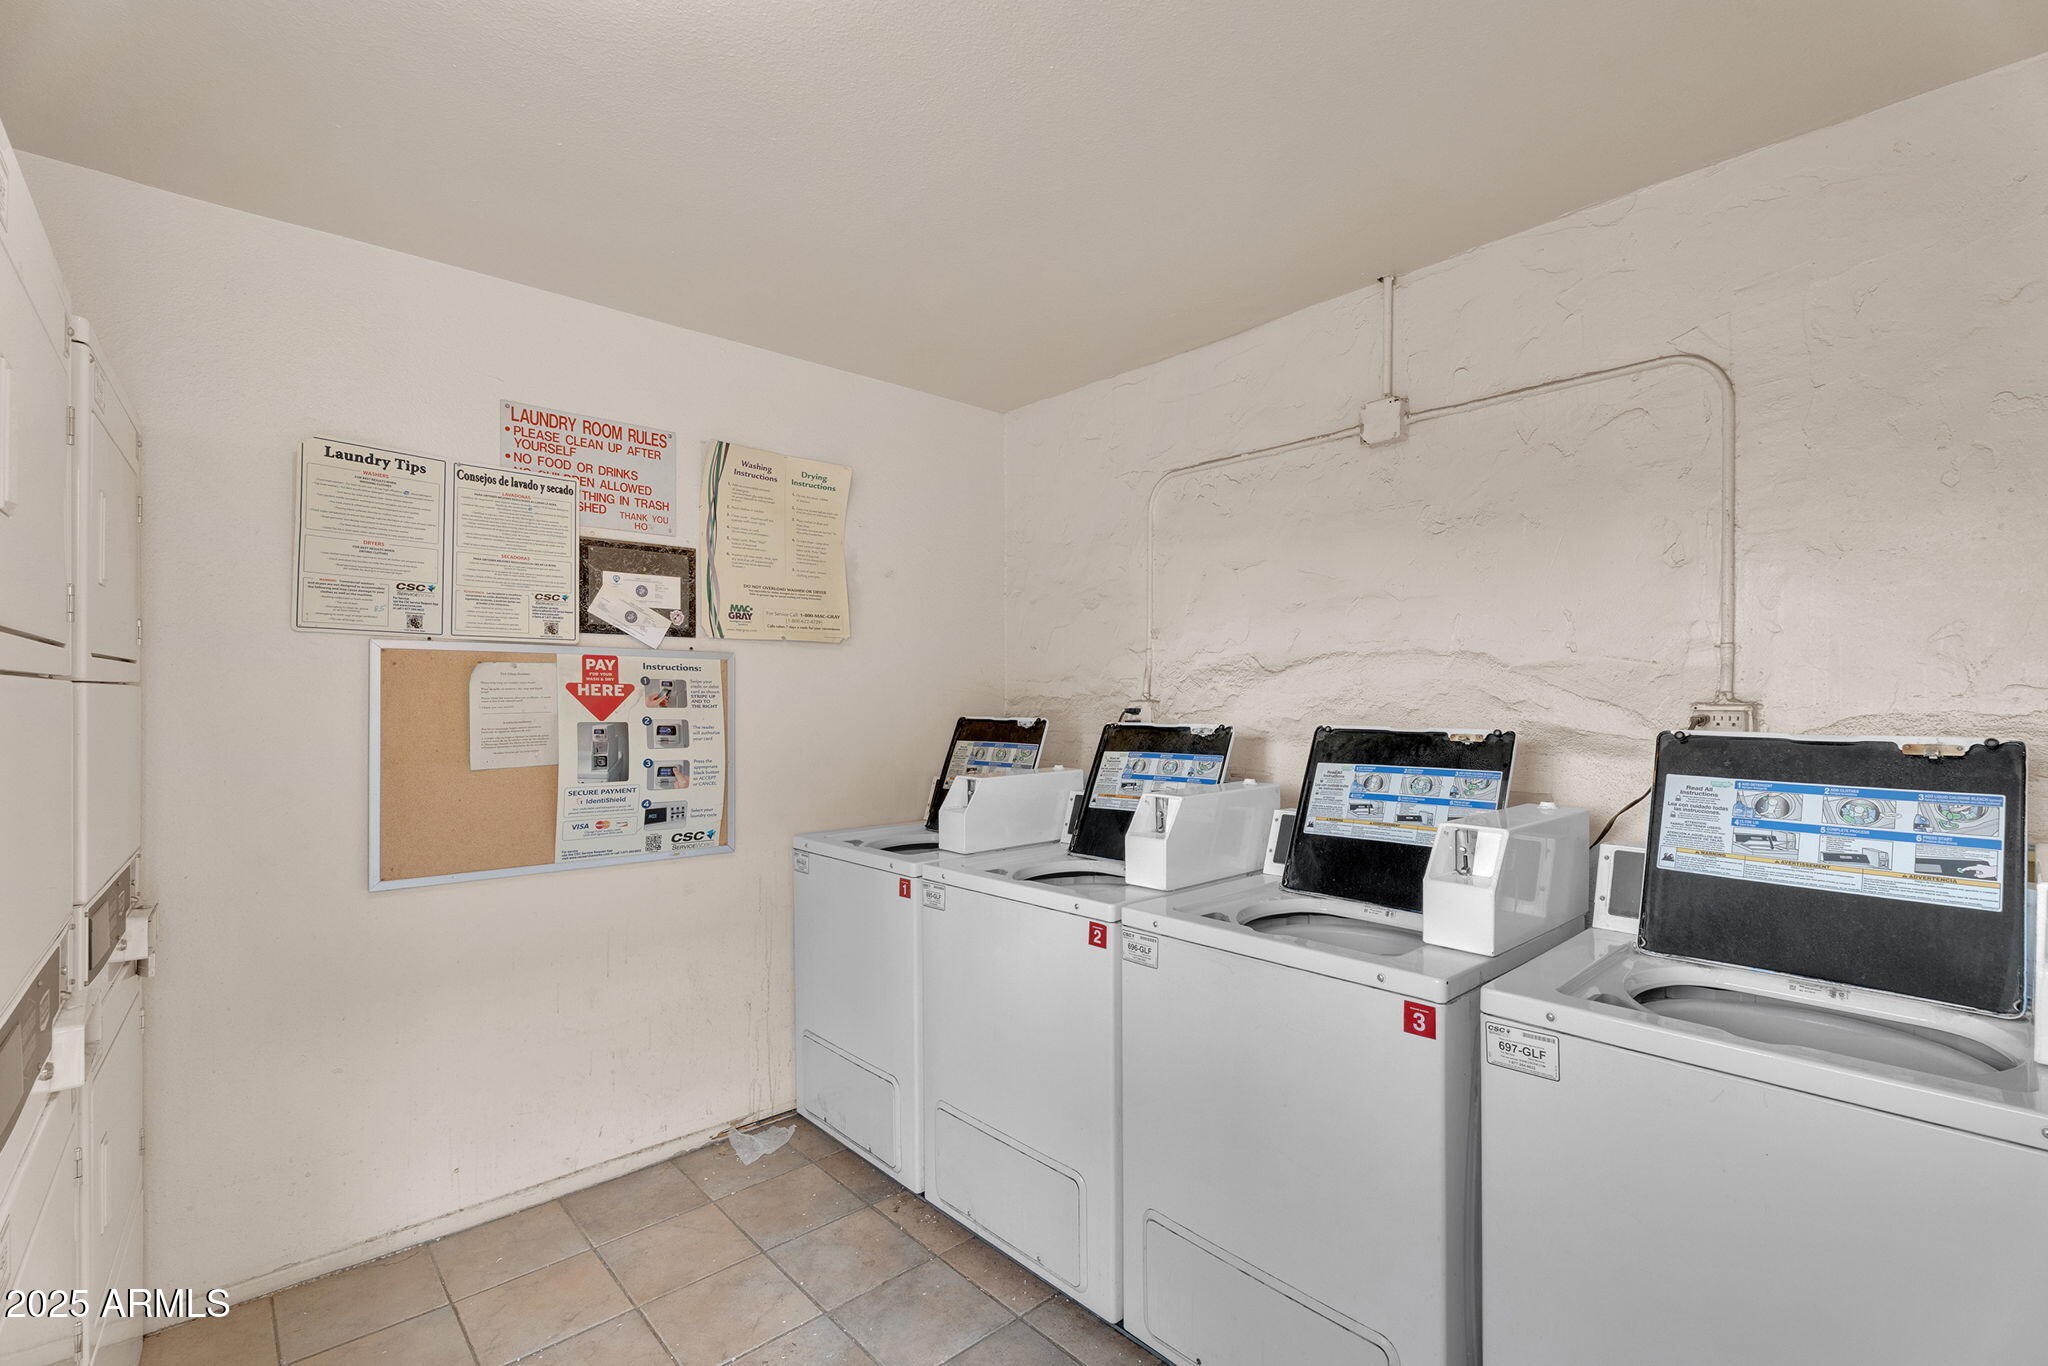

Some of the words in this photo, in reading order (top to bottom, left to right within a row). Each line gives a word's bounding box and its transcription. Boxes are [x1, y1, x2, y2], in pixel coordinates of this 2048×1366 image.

[511, 406, 577, 432] LAUNDRY
[583, 420, 623, 440] ROOM
[628, 429, 668, 449] RULES
[514, 426, 560, 443] PLEASE
[566, 435, 604, 450] CLEAN
[608, 443, 623, 454] UP
[627, 446, 662, 460] AFTER
[514, 438, 577, 457] YOURSELF
[324, 445, 391, 471] Laundry
[395, 458, 427, 476] Tips
[514, 452, 532, 465] NO
[538, 457, 572, 470] FOOD
[577, 462, 594, 474] OR
[598, 466, 639, 481] DRINKS
[741, 460, 773, 474] Washing
[363, 470, 390, 479] WASHERS
[733, 468, 778, 483] Instructions
[801, 471, 828, 483] Drying
[456, 469, 497, 487] Consejos
[499, 478, 509, 487] de
[511, 479, 539, 490] lavado
[540, 484, 546, 494] y
[547, 484, 574, 496] secado
[600, 479, 653, 496] ALLOWED
[791, 479, 836, 492] Instructions
[579, 490, 615, 505] THING
[620, 497, 630, 506] IN
[634, 498, 670, 511] TRASH
[620, 512, 648, 522] THANK
[652, 514, 669, 525] YOU
[396, 583, 426, 592] CSC
[535, 593, 561, 602] CSC
[728, 612, 753, 621] GRAY
[585, 658, 616, 671] PAY
[643, 663, 702, 672] Instructions:
[578, 684, 625, 697] HERE
[1680, 790, 1719, 798] Instructions
[586, 797, 627, 805] IdentiShield
[1683, 808, 1721, 816] instrucciones.
[671, 831, 705, 843] CSC
[1780, 860, 1831, 870] AVERTISSEMENT
[1908, 874, 1958, 884] ADVERTENCIA
[903, 884, 907, 896] 1
[1094, 930, 1102, 944] 2
[1128, 943, 1153, 955] 696-GLF
[1413, 1012, 1426, 1032] 3
[1488, 1025, 1506, 1033] CSC
[1498, 1041, 1546, 1060] 697-GLF
